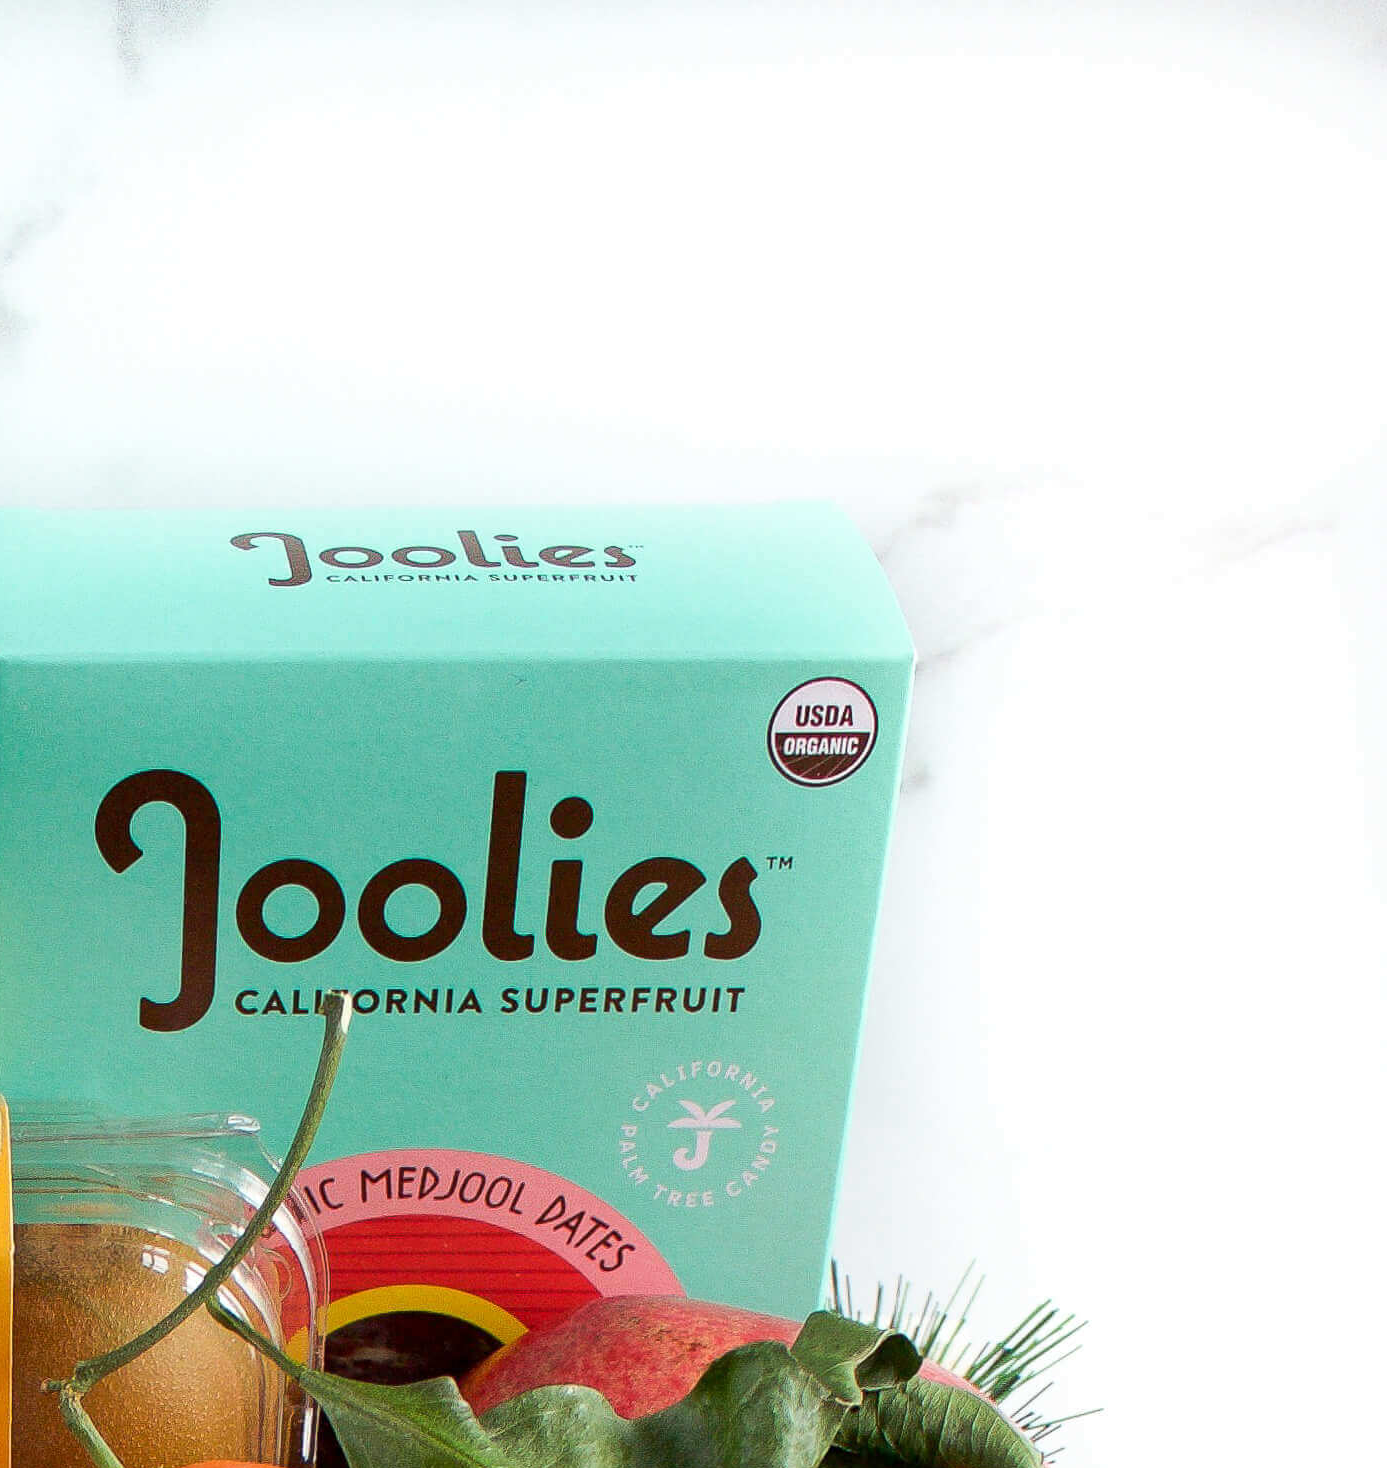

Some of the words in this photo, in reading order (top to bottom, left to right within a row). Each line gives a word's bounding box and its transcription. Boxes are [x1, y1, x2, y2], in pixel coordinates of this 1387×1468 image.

[326, 574, 478, 583] CALIFORNIA
[488, 574, 639, 583] SUPERFRUIT
[795, 704, 854, 727] USDA
[783, 737, 860, 756] ORGANIC
[235, 987, 483, 1016] CALIORNIA
[499, 986, 746, 1014] SUPERFRUIT
[632, 1060, 775, 1112] CALIFORNIA
[619, 1124, 649, 1186] PALM
[653, 1184, 715, 1208] TREE
[725, 1125, 780, 1198] CANDY
[360, 1166, 527, 1215] MEDJOOL
[534, 1194, 636, 1273] DATES
